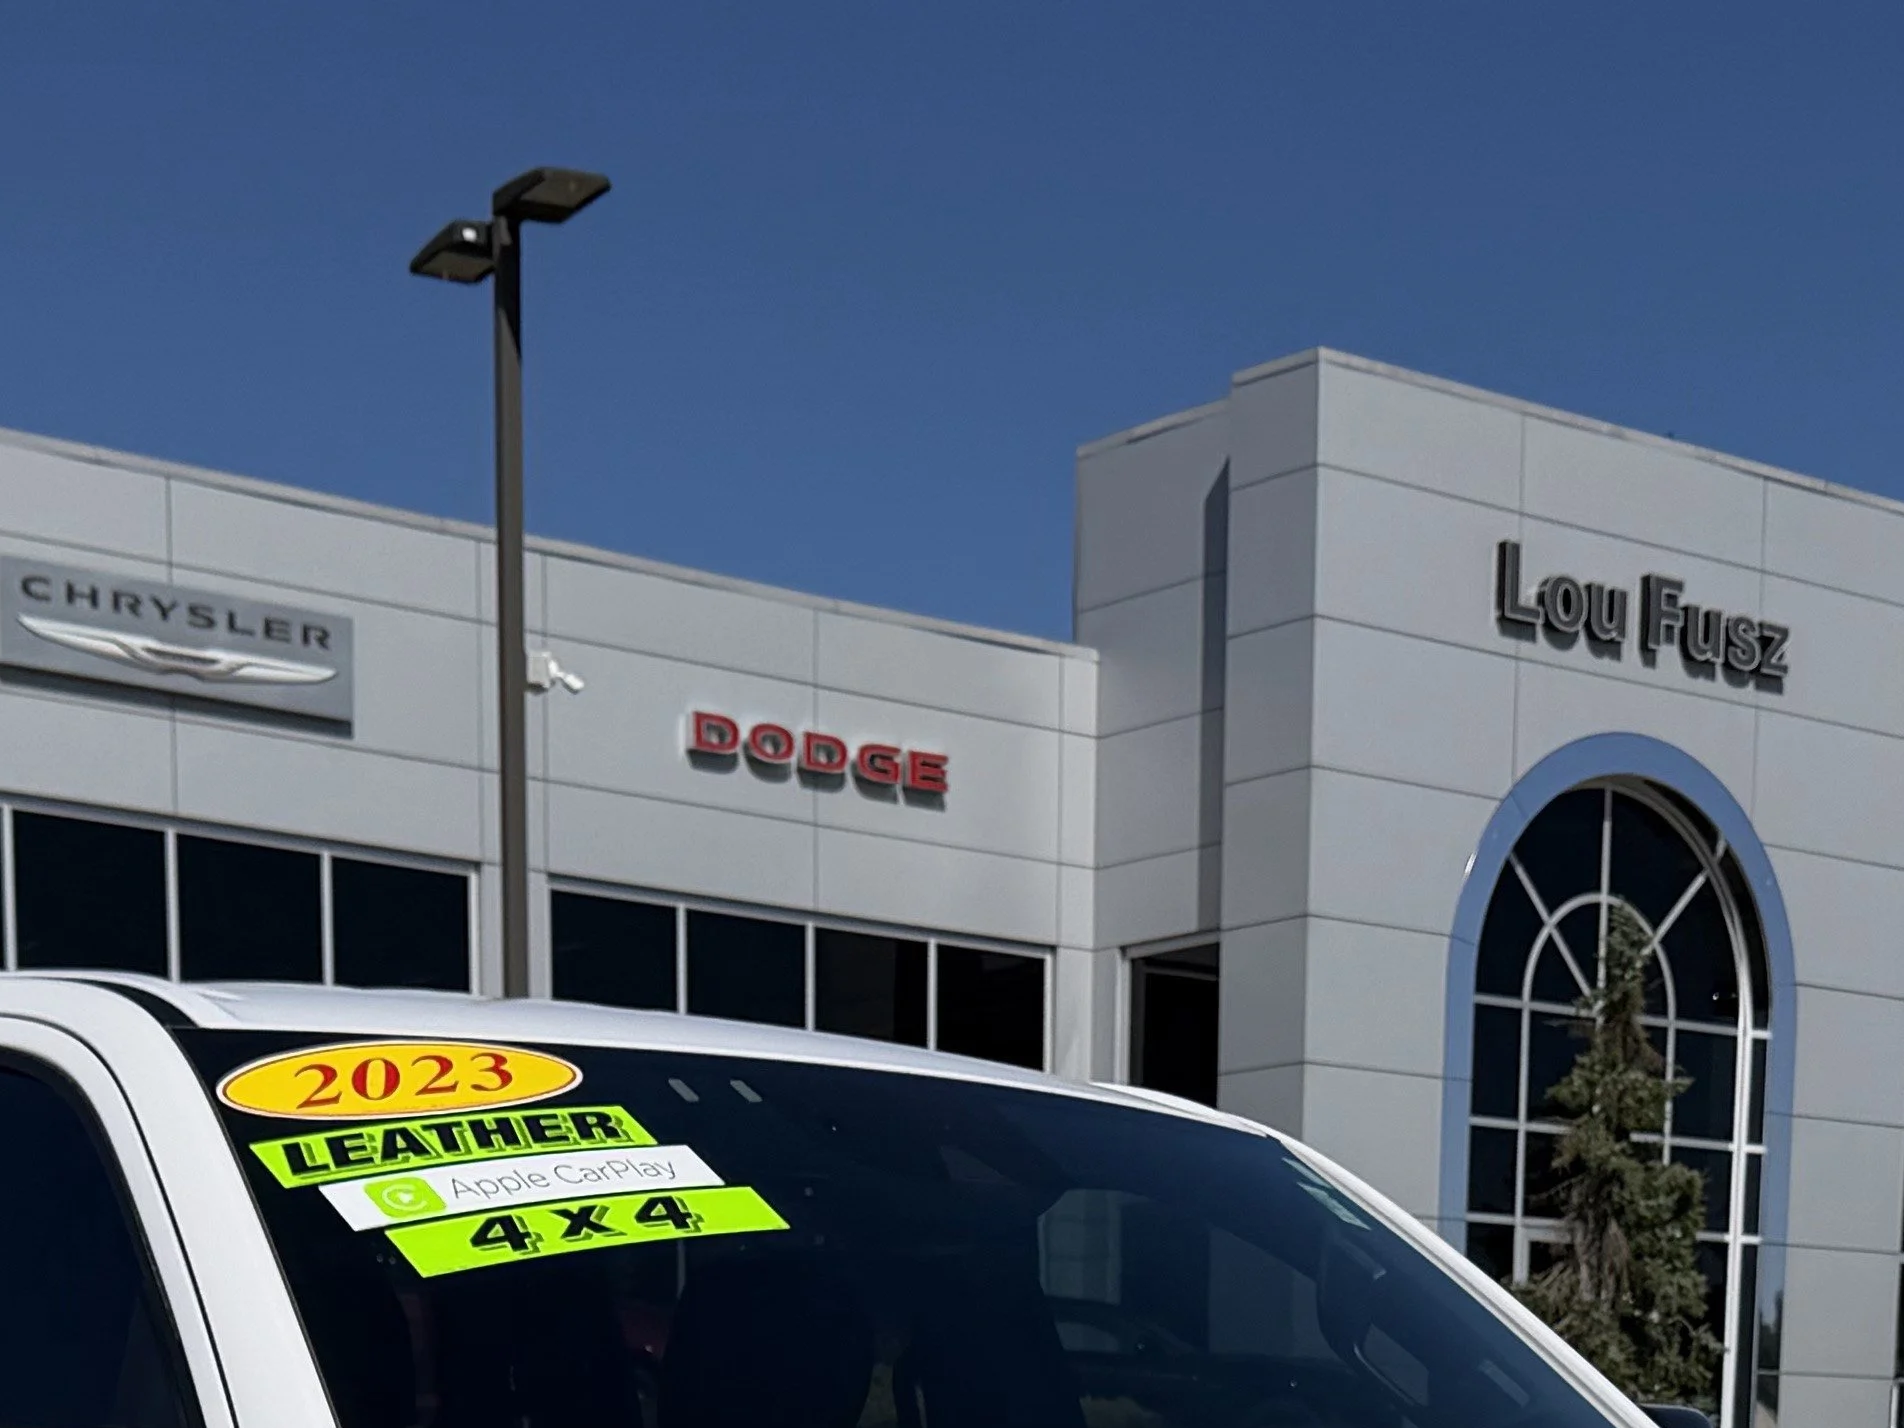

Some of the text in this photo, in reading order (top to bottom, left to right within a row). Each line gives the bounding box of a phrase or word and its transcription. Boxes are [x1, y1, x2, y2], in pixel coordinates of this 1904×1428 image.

[20, 576, 332, 653] CHRYSLER
[1496, 540, 1790, 678] Lou Fusz
[693, 711, 950, 794] DODGE
[295, 1052, 514, 1109] 2023
[281, 1109, 626, 1178] LEATHER
[450, 1154, 678, 1201] Apple CarPlay
